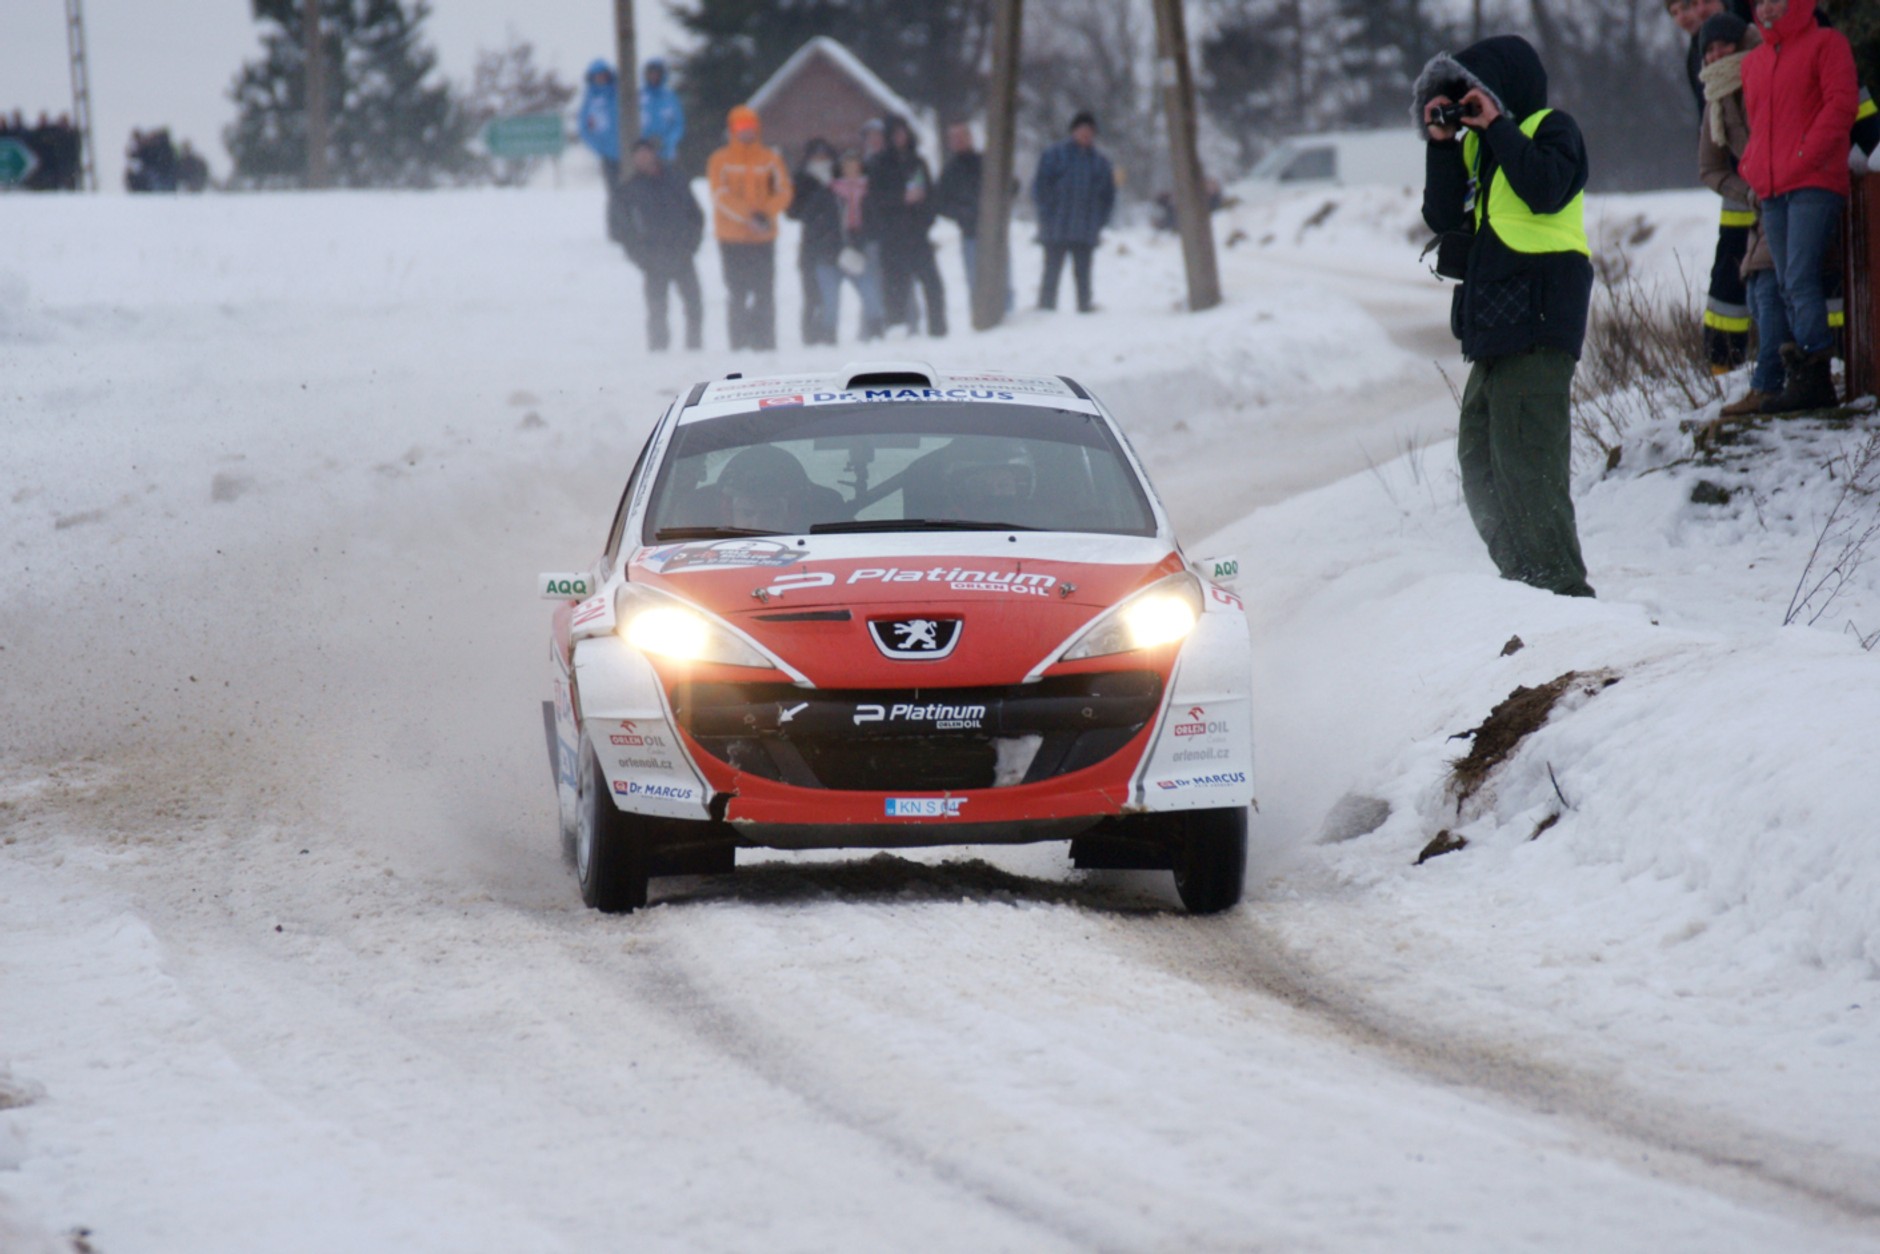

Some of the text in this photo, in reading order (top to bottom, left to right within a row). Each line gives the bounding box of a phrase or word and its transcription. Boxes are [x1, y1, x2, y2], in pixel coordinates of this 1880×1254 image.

[866, 389, 1014, 400] MARCUS
[846, 568, 1057, 588] Platinum
[546, 580, 587, 595] AQQ
[1010, 585, 1050, 597] OIL
[889, 704, 986, 720] Platinum
[964, 720, 982, 729] OIL
[1175, 721, 1229, 735] ORLEN OIL
[644, 735, 666, 747] OIL
[1173, 748, 1230, 762] orlenoil.cz
[618, 757, 673, 769] orlenoil.cz
[1192, 772, 1246, 785] MARCUS
[645, 785, 693, 799] MARCUS
